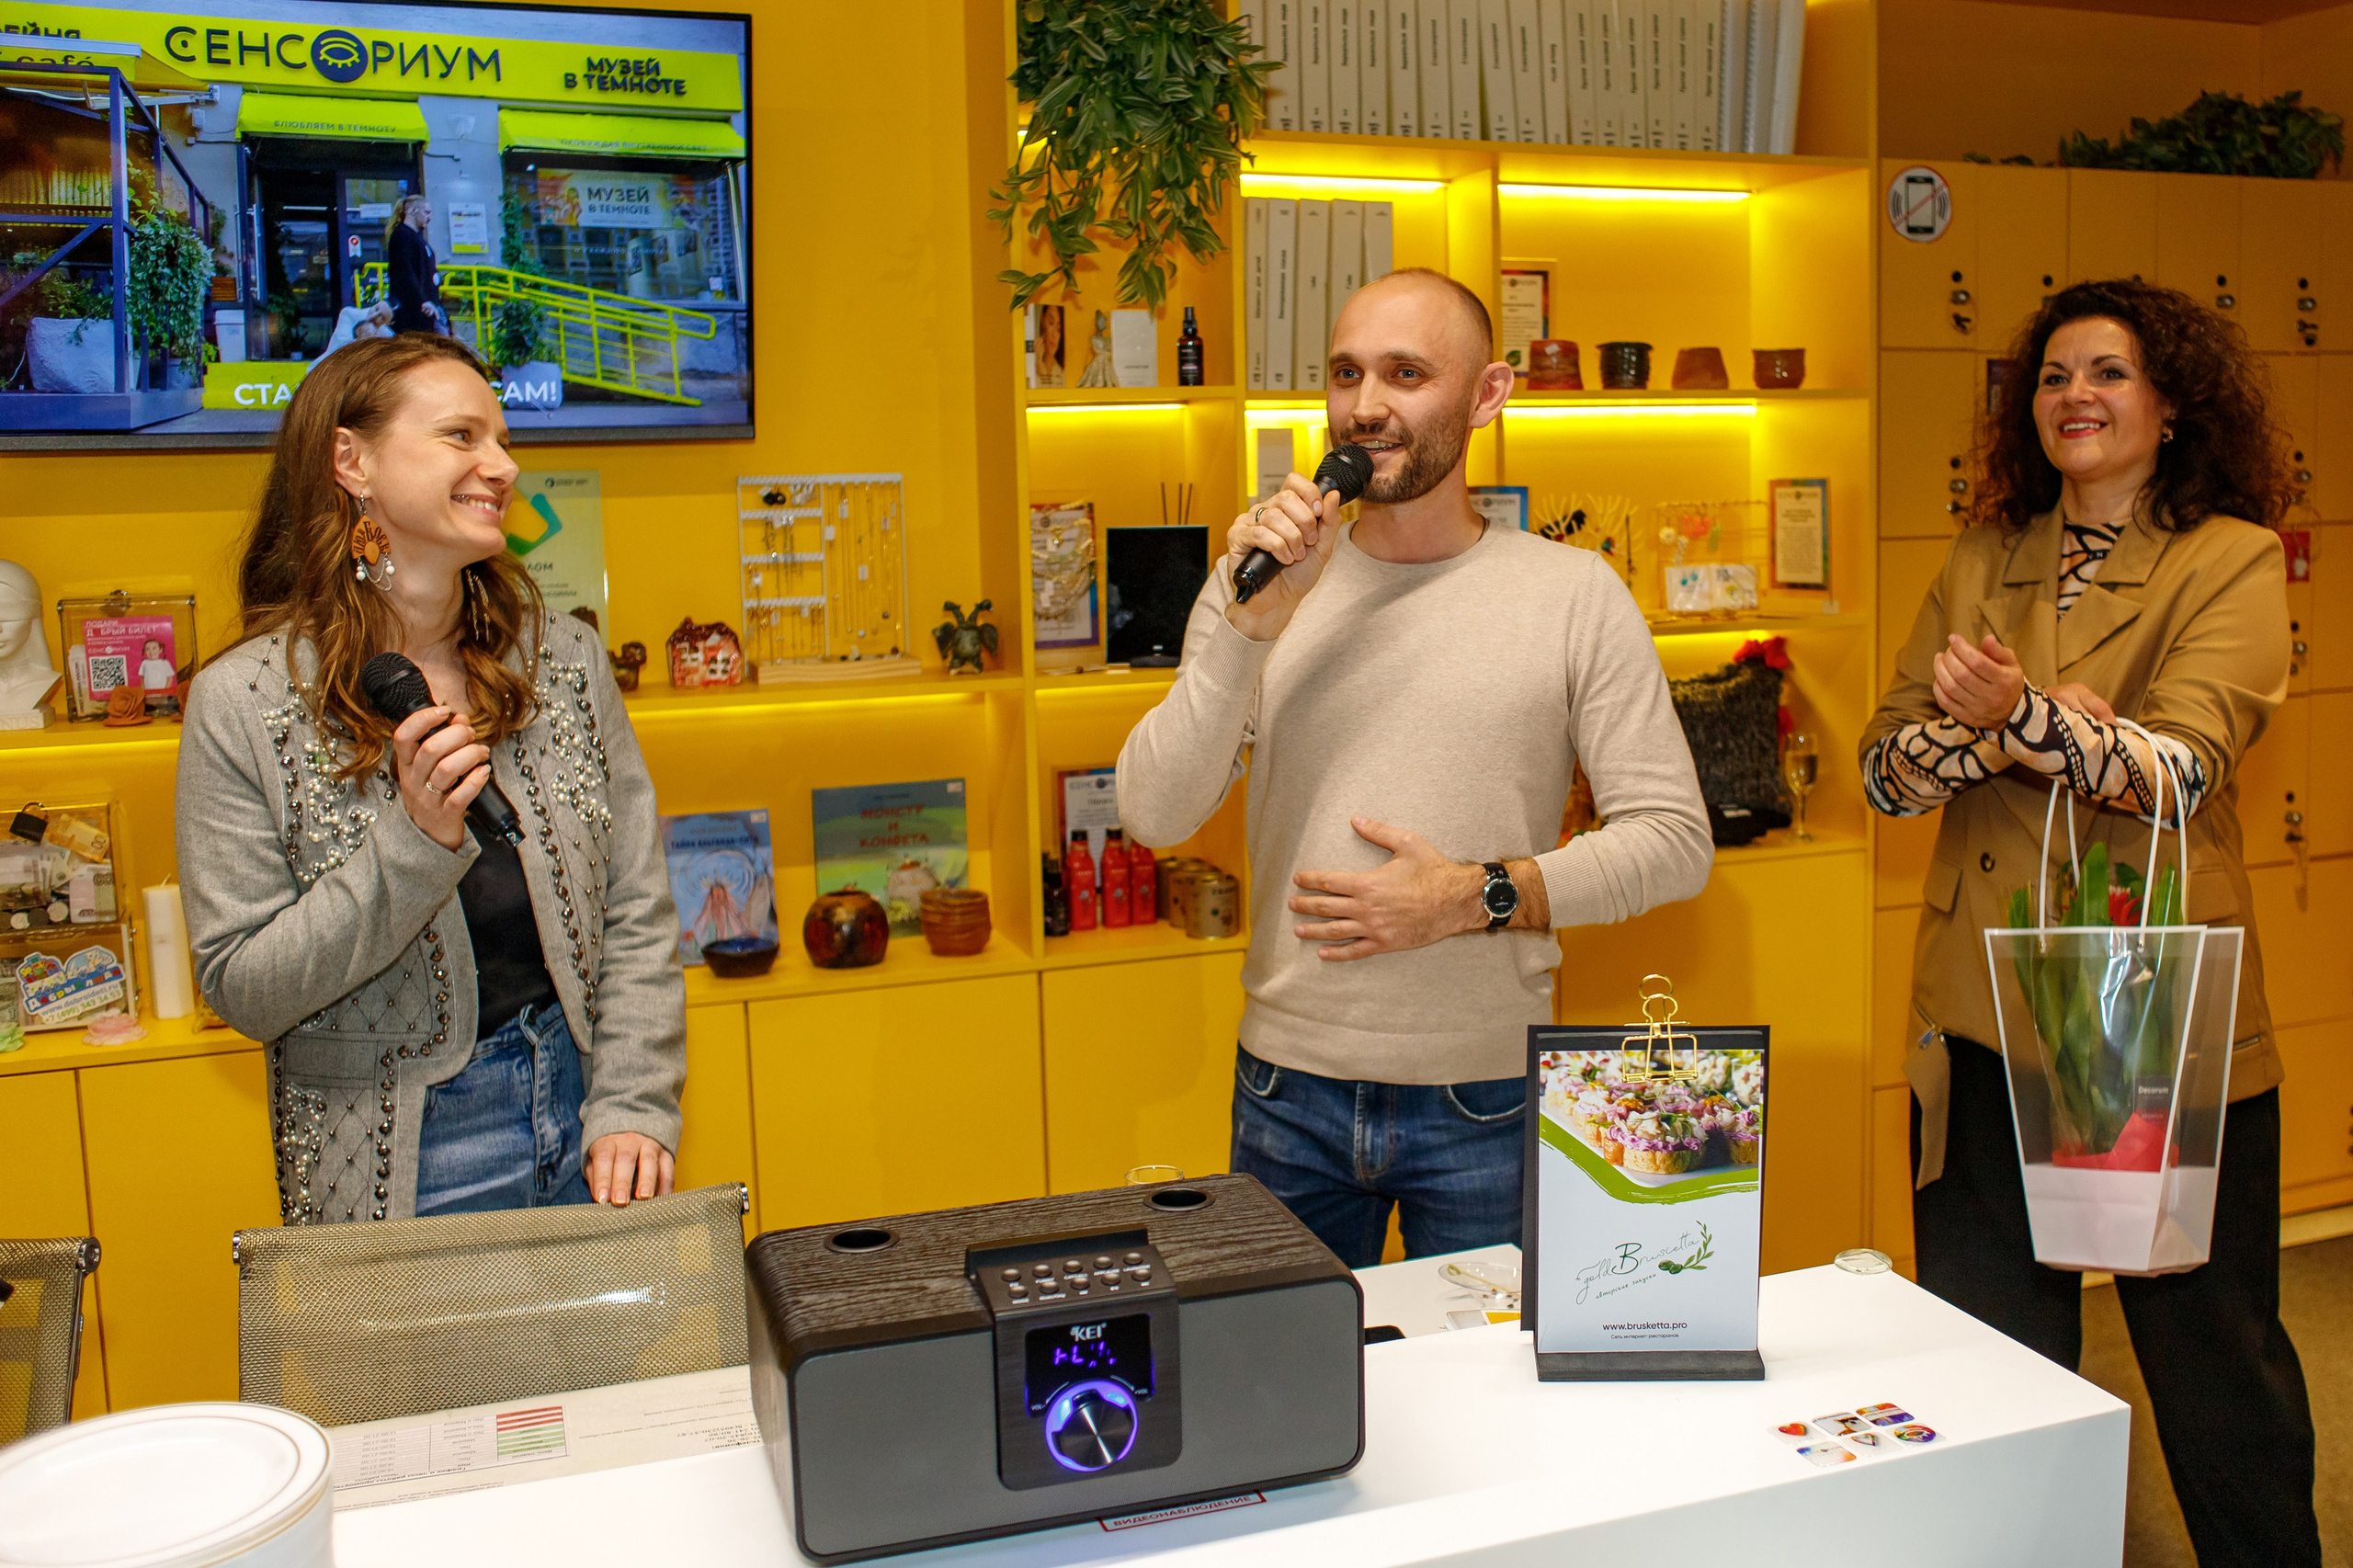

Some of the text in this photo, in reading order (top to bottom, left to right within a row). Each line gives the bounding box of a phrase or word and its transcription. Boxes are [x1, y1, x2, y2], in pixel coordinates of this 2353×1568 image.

[165, 26, 502, 83] СЕНСОРИУМ
[587, 57, 662, 77] МУЗЕЙ
[564, 73, 688, 96] В ТЕМНОТЕ
[274, 119, 335, 131] ВЛЮБЛЯЕМ
[347, 124, 397, 133] ТЕМНОТУ
[586, 186, 651, 203] МУЗЕЙ
[587, 204, 652, 215] В ТЕМНОТЕ
[233, 382, 301, 405] СТА
[860, 803, 924, 819] МОНСТР
[2138, 1085, 2169, 1095] Decorum
[1595, 1282, 1629, 1300] авторские
[1602, 1321, 1688, 1331] www.brusketta.pro
[1113, 1496, 1251, 1527] ВИДЕОНАБЛЮДЕНИЕ
